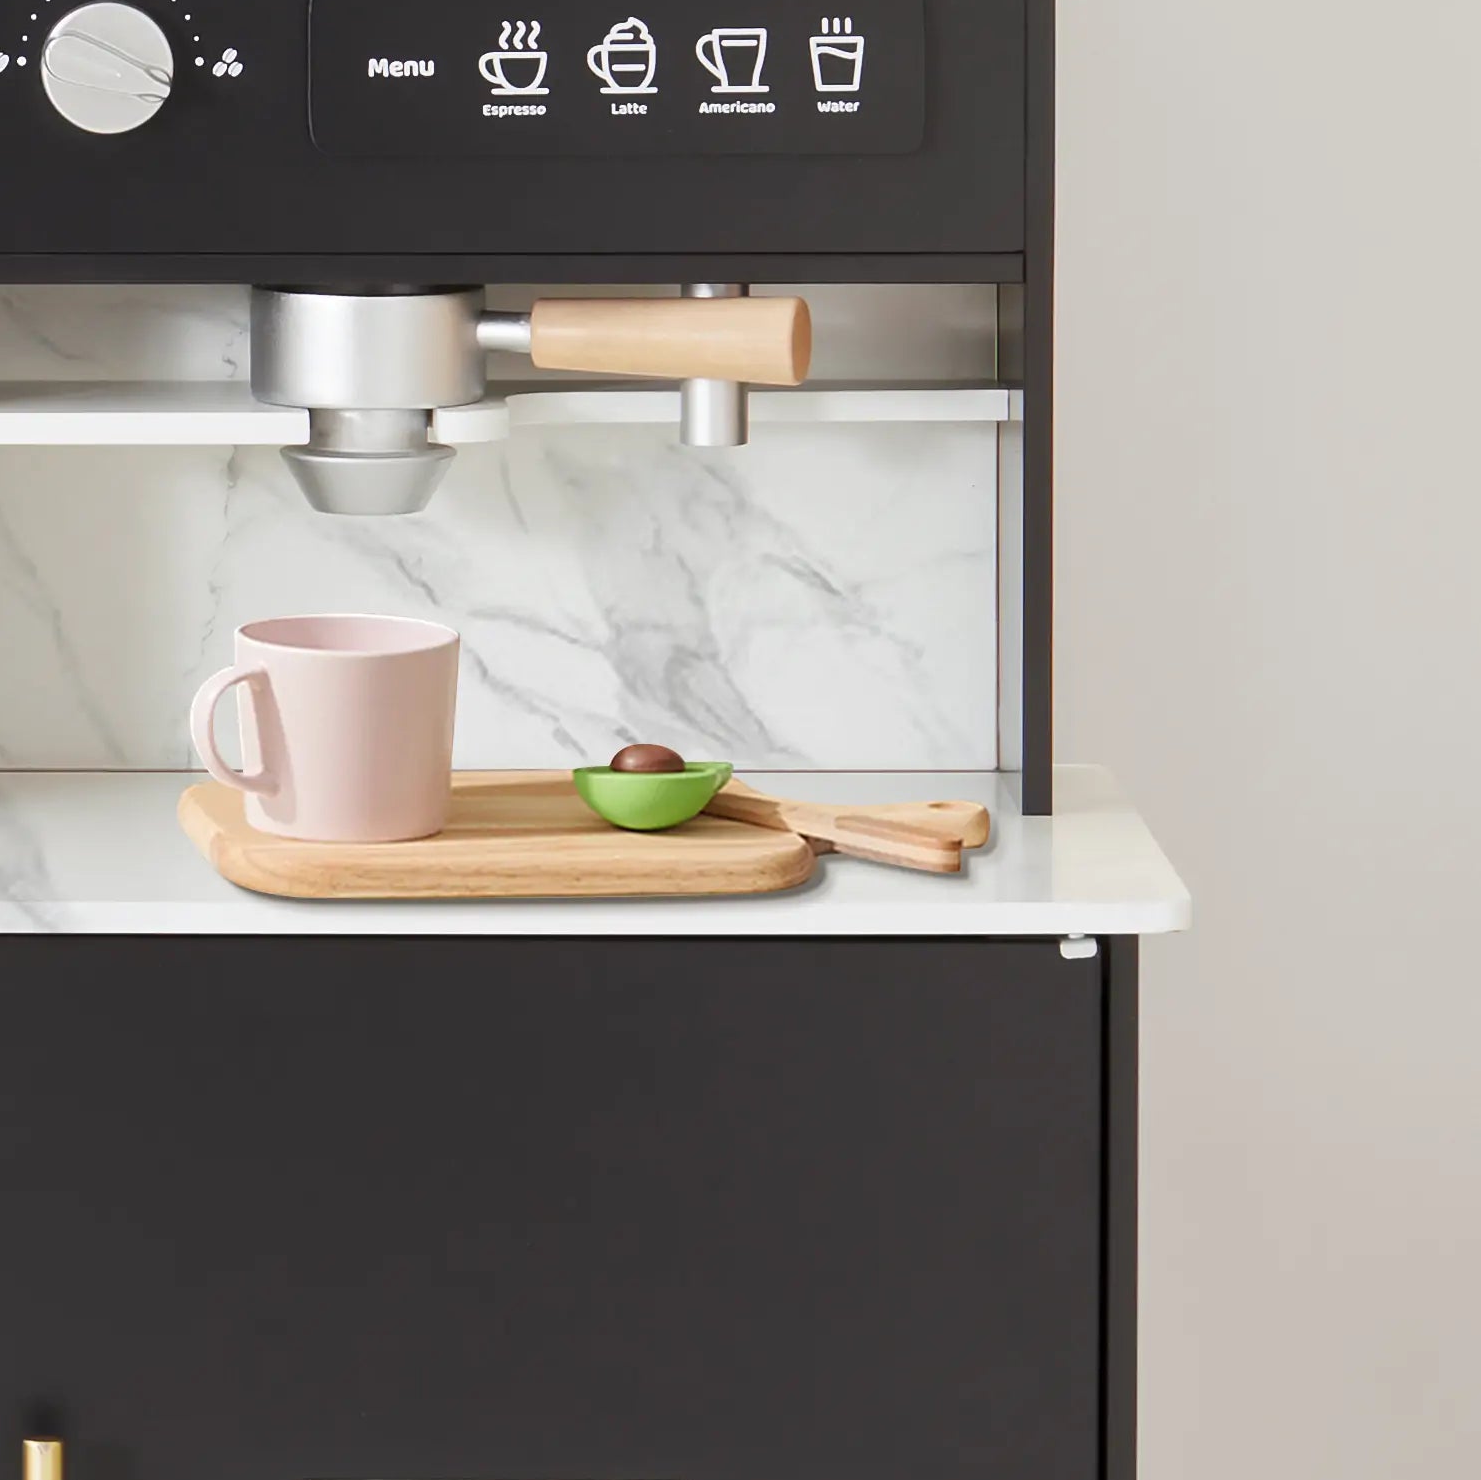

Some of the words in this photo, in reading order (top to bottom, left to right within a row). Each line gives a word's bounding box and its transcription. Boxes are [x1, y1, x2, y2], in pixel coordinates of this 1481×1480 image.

[367, 57, 435, 78] Menu
[482, 103, 547, 119] Espresso
[610, 102, 648, 115] Latte
[698, 100, 776, 114] Americano
[816, 100, 860, 113] Water
